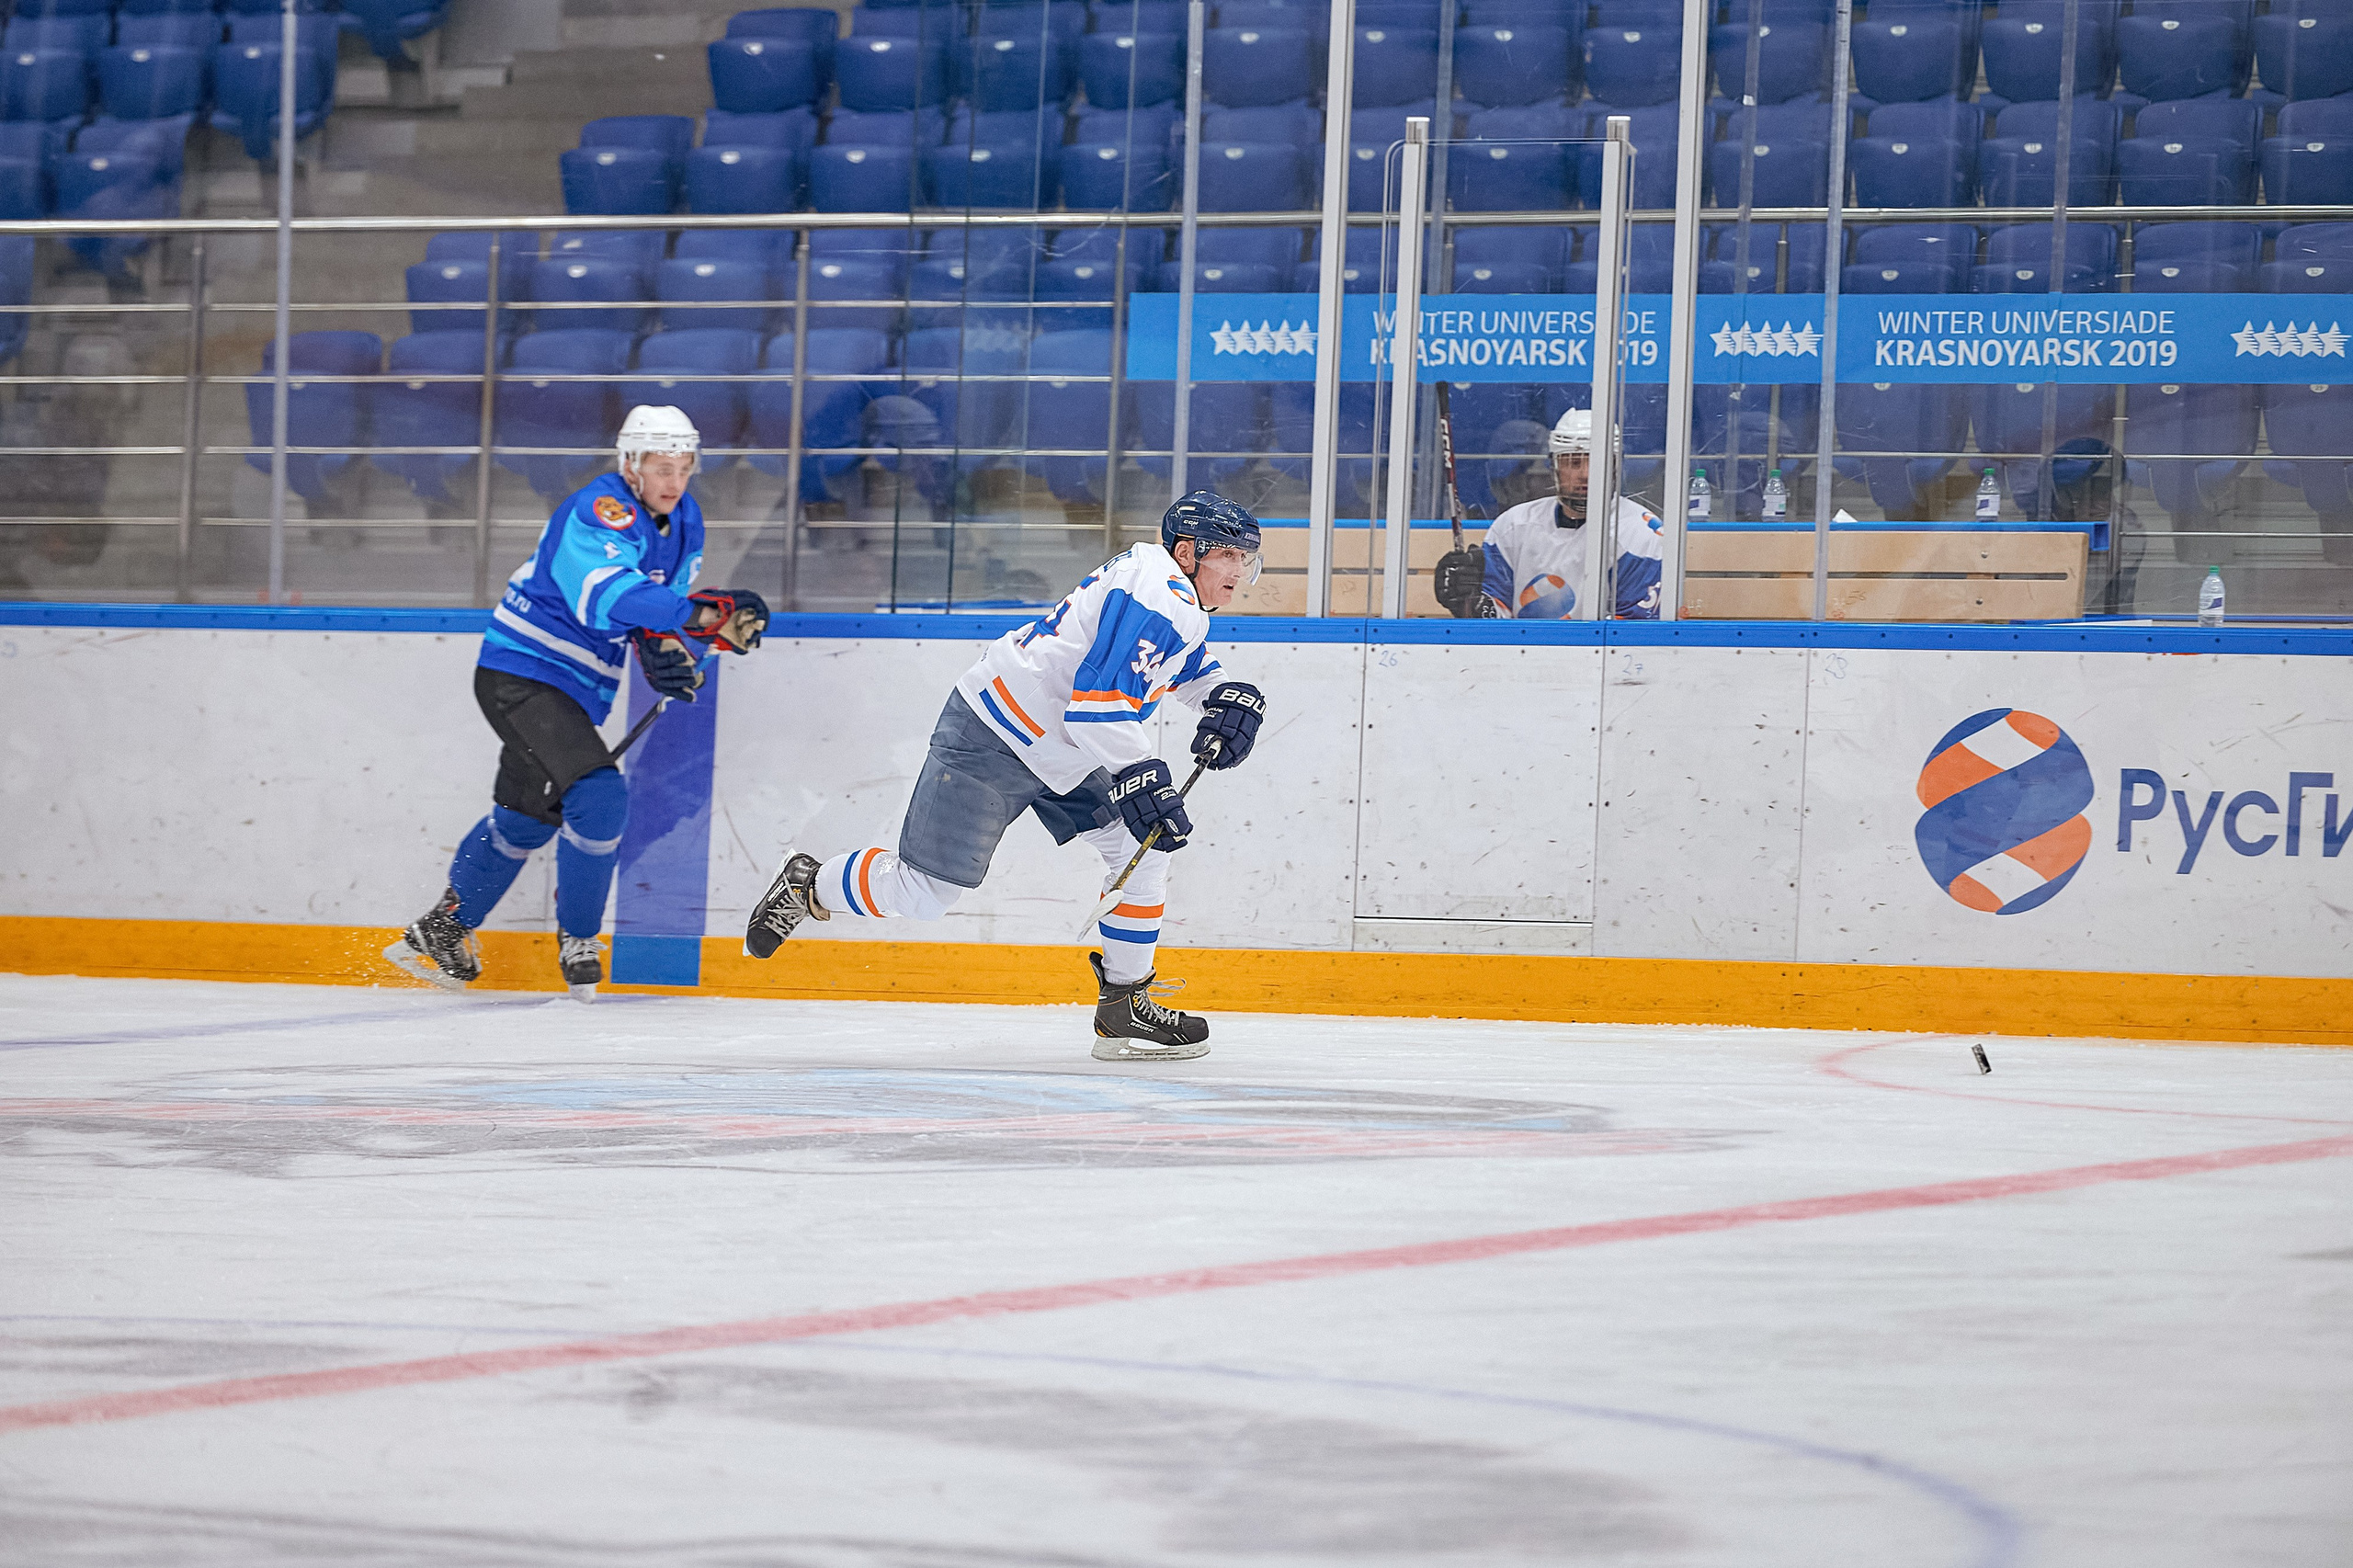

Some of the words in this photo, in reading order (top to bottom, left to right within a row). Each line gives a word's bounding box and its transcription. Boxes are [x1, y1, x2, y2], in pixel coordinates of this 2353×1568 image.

[1372, 310, 1474, 335] WTER
[1480, 310, 1657, 335] UNIVERSDE
[1878, 310, 1984, 335] WINTER
[1991, 309, 2176, 335] UNIVERSIADE
[1370, 337, 1588, 367] KASNOYARSK
[1618, 339, 1658, 367] 19
[1875, 337, 2103, 367] KRASNOYARSK
[2109, 339, 2178, 367] 2019
[1439, 418, 1452, 469] CCM
[1379, 650, 1398, 668] 26
[1622, 653, 1643, 676] 27
[1218, 688, 1266, 715] BAU
